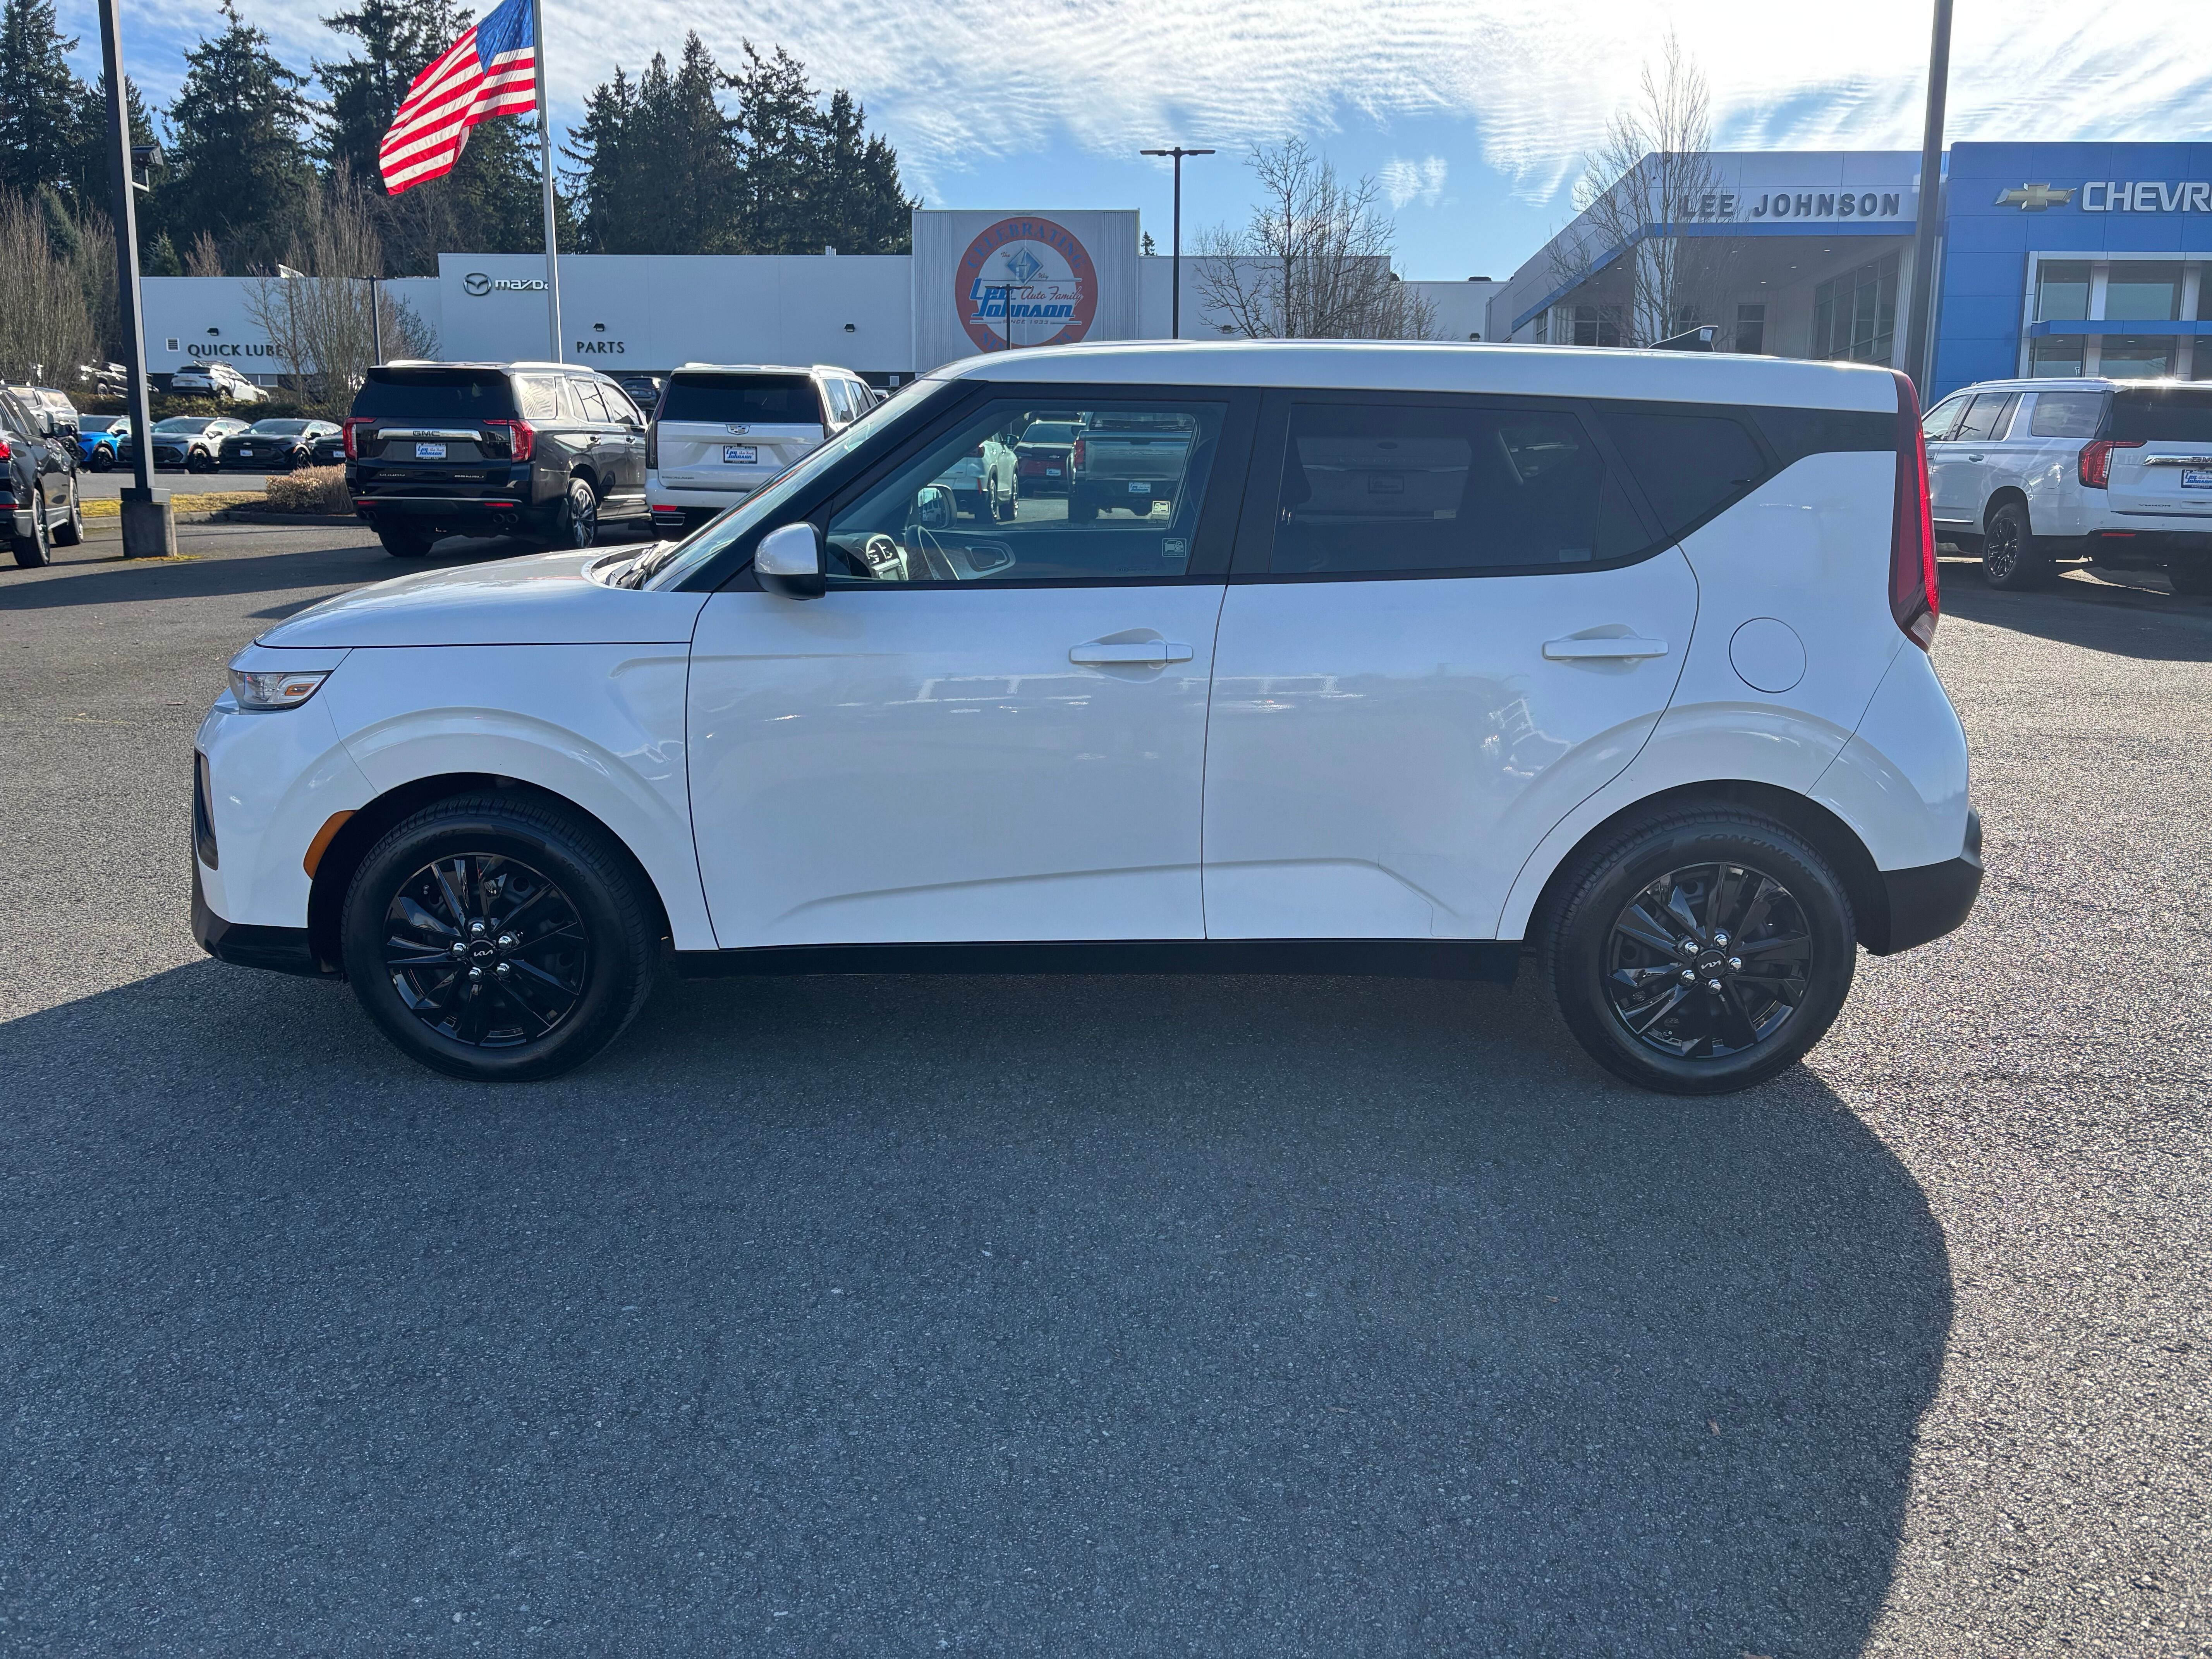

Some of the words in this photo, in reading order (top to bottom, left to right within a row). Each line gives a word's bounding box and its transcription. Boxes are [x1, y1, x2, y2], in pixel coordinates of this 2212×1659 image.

[1683, 194, 1735, 217] LEE
[1753, 193, 1900, 216] JOHNSON
[2083, 182, 2212, 211] CHEVR
[967, 223, 1086, 269] CELEBRATING
[972, 292, 1075, 317] Johnson
[1021, 288, 1046, 300] Auto
[1048, 286, 1084, 306] Family
[187, 344, 242, 358] QUICK
[245, 344, 284, 357] LUBE
[577, 341, 625, 353] PARTS
[1701, 960, 1721, 969] KIA
